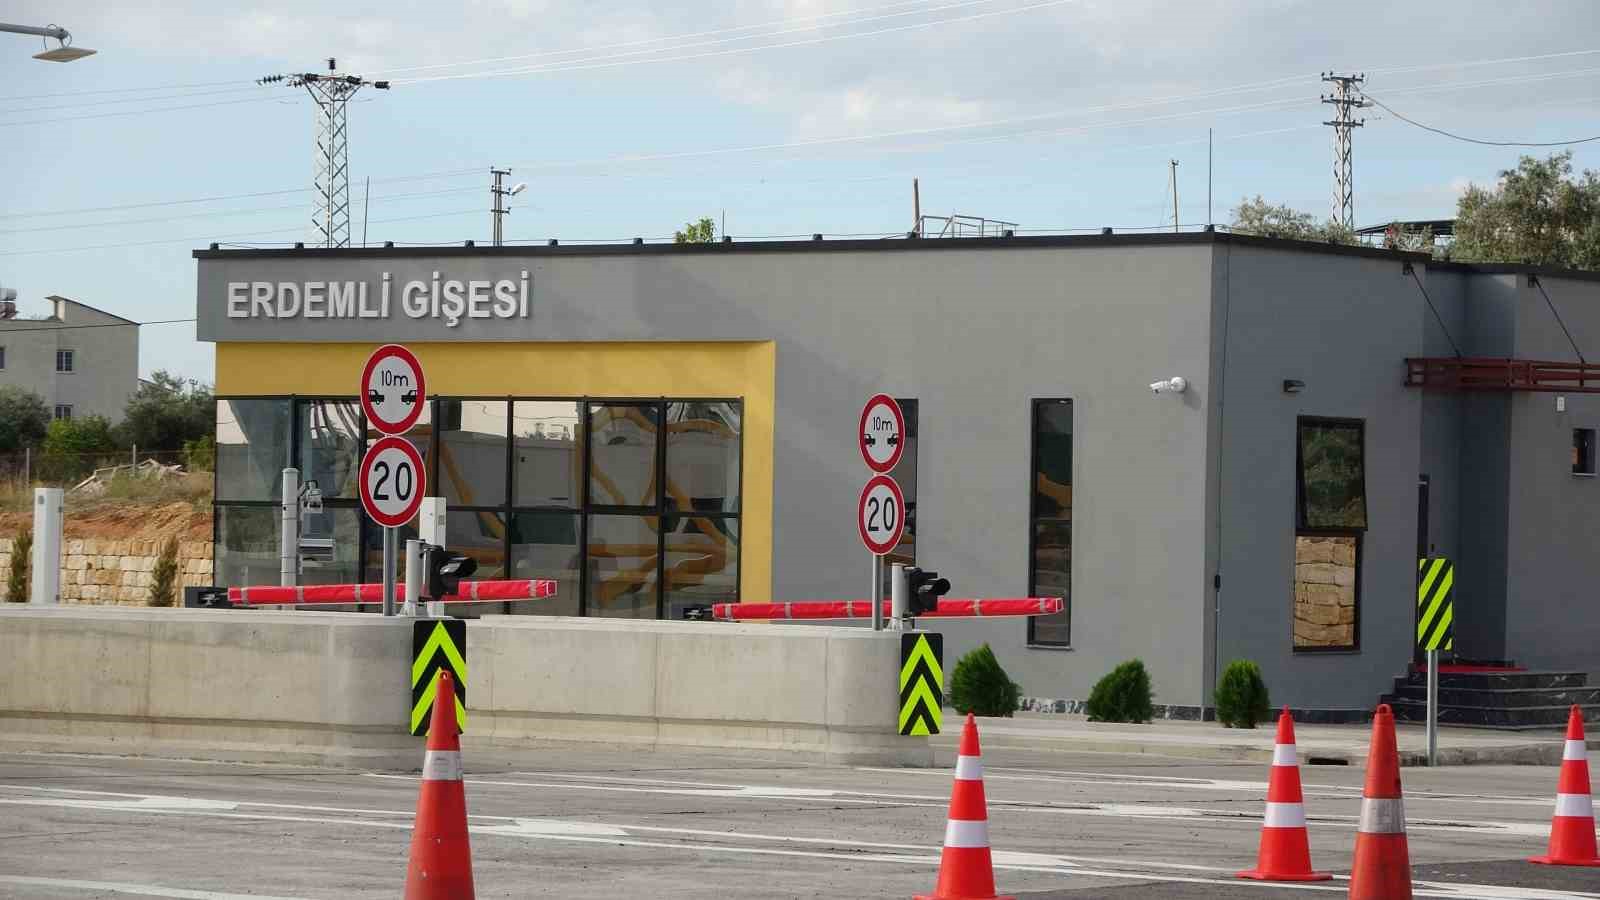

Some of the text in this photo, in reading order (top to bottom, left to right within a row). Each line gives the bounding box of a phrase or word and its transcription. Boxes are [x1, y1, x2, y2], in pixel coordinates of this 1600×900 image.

[226, 270, 529, 327] ERDEMLİ GİŞESİ
[381, 370, 409, 387] 10m
[873, 416, 893, 431] 10m
[373, 461, 413, 501] 20
[867, 496, 896, 532] 20
